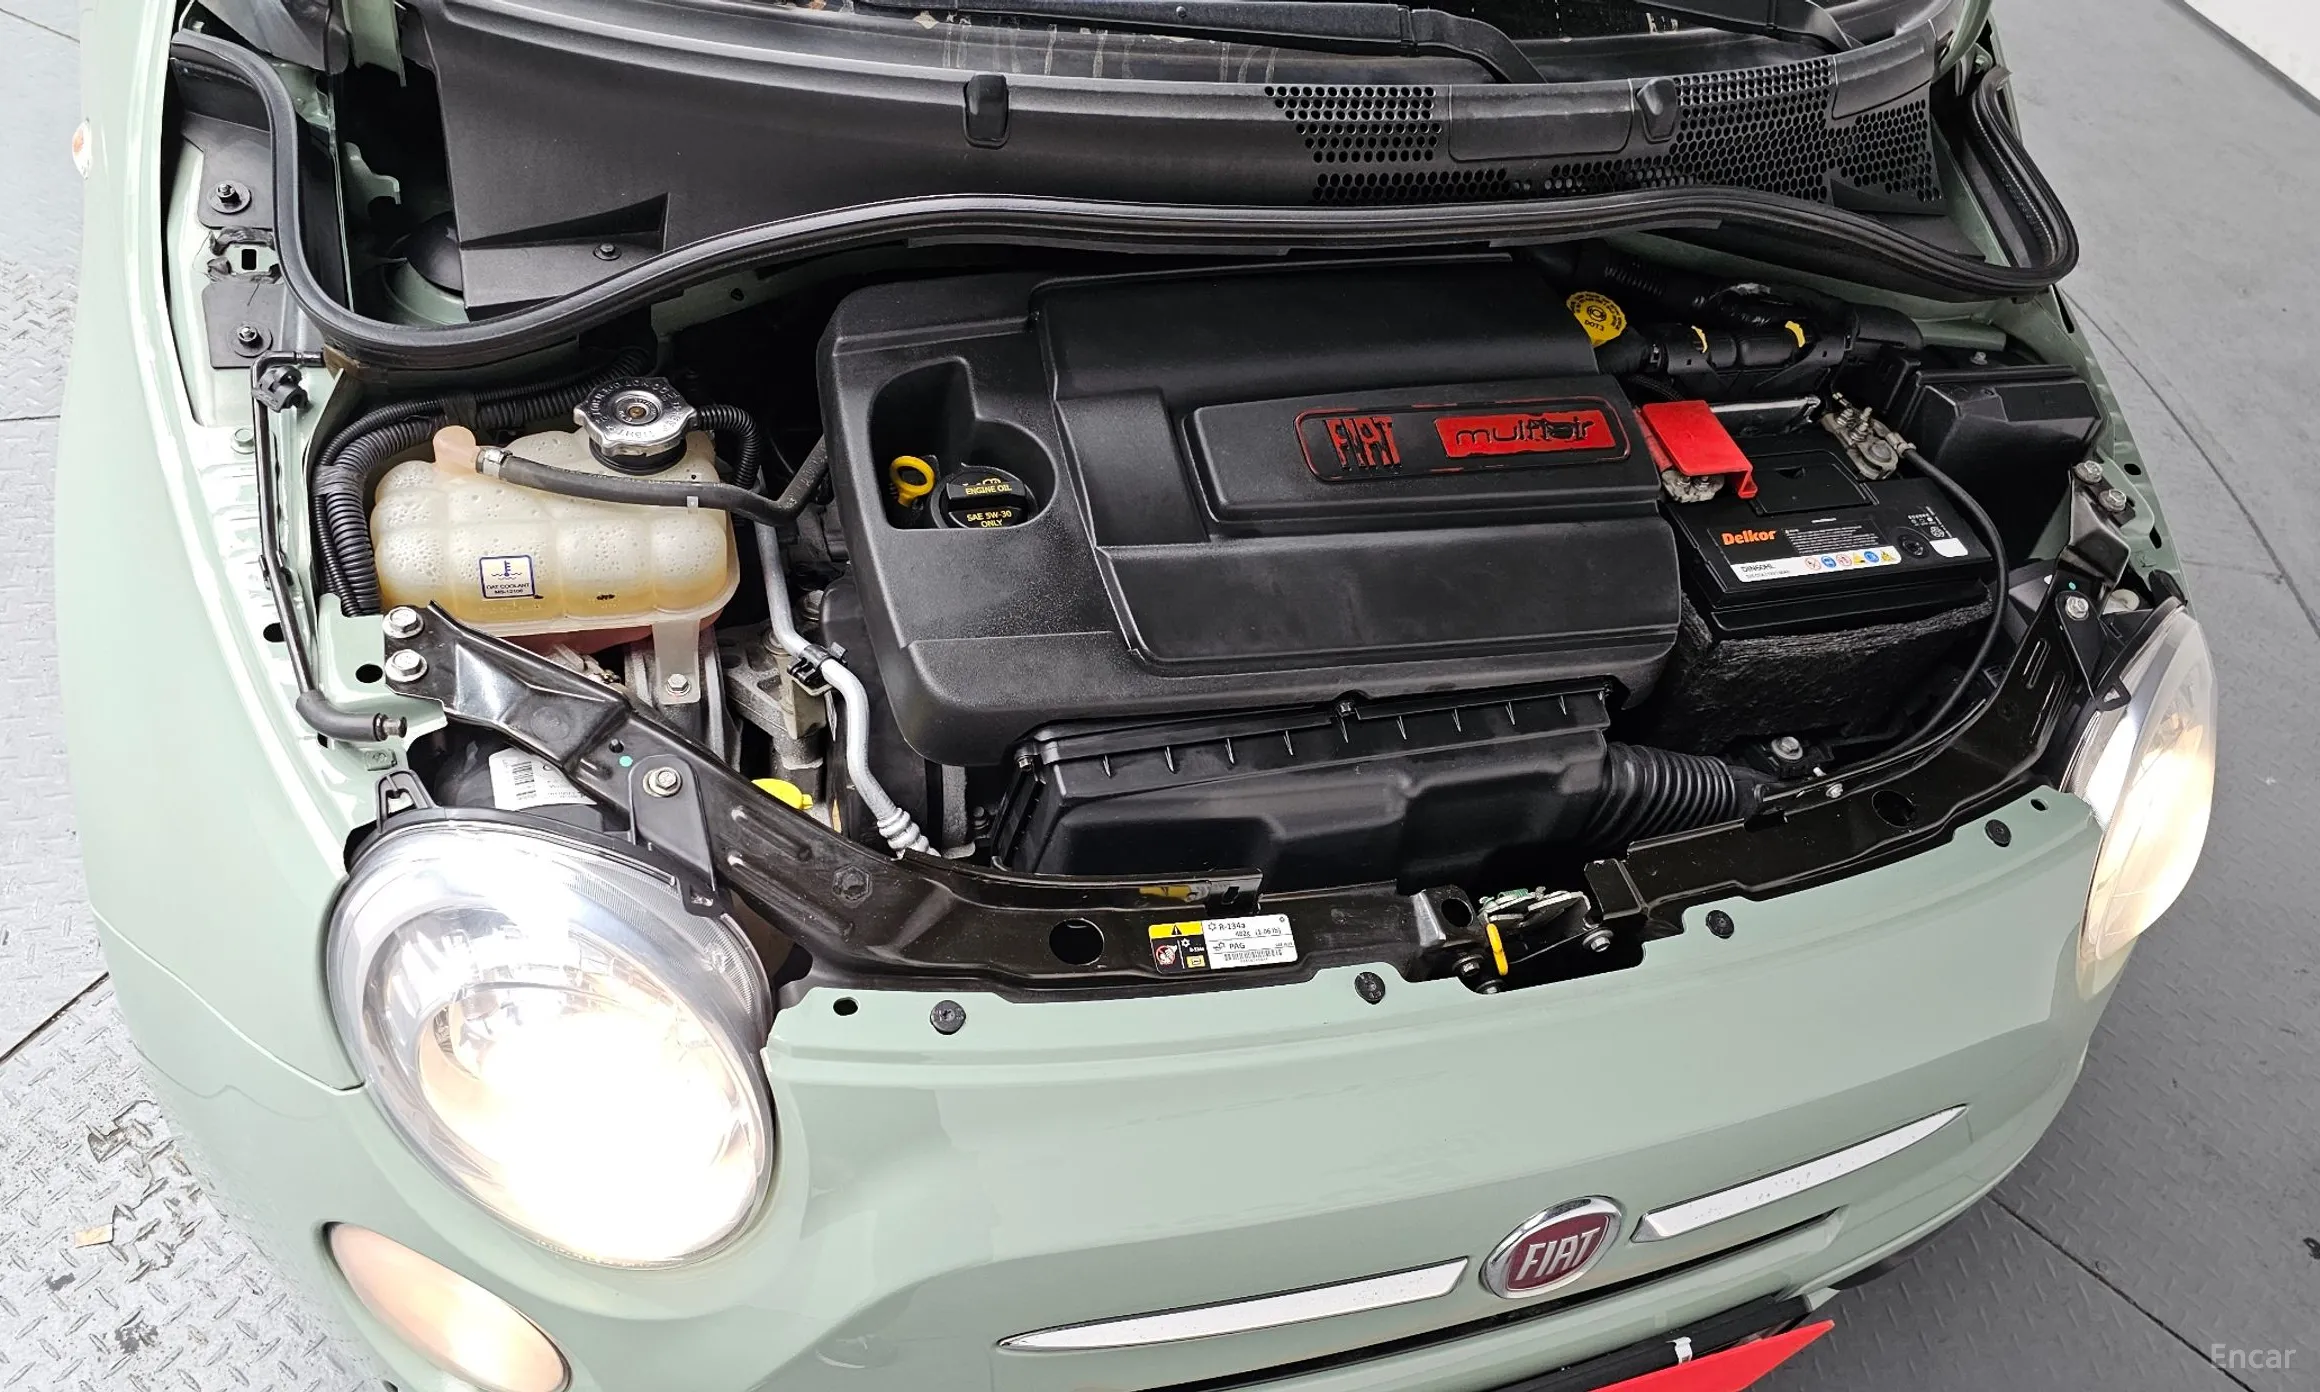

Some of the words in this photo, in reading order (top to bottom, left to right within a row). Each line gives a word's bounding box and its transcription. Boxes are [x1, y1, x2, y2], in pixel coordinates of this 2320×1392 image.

[1324, 416, 1401, 468] FIAT
[965, 486, 997, 495] ENGINE
[997, 484, 1013, 492] OIL
[967, 513, 984, 521] SAE
[985, 510, 1012, 519] 5W-30
[981, 519, 1003, 527] ONLY
[1721, 529, 1777, 546] Delkor
[1218, 922, 1246, 931] R-134a
[1515, 1227, 1601, 1281] FIAT
